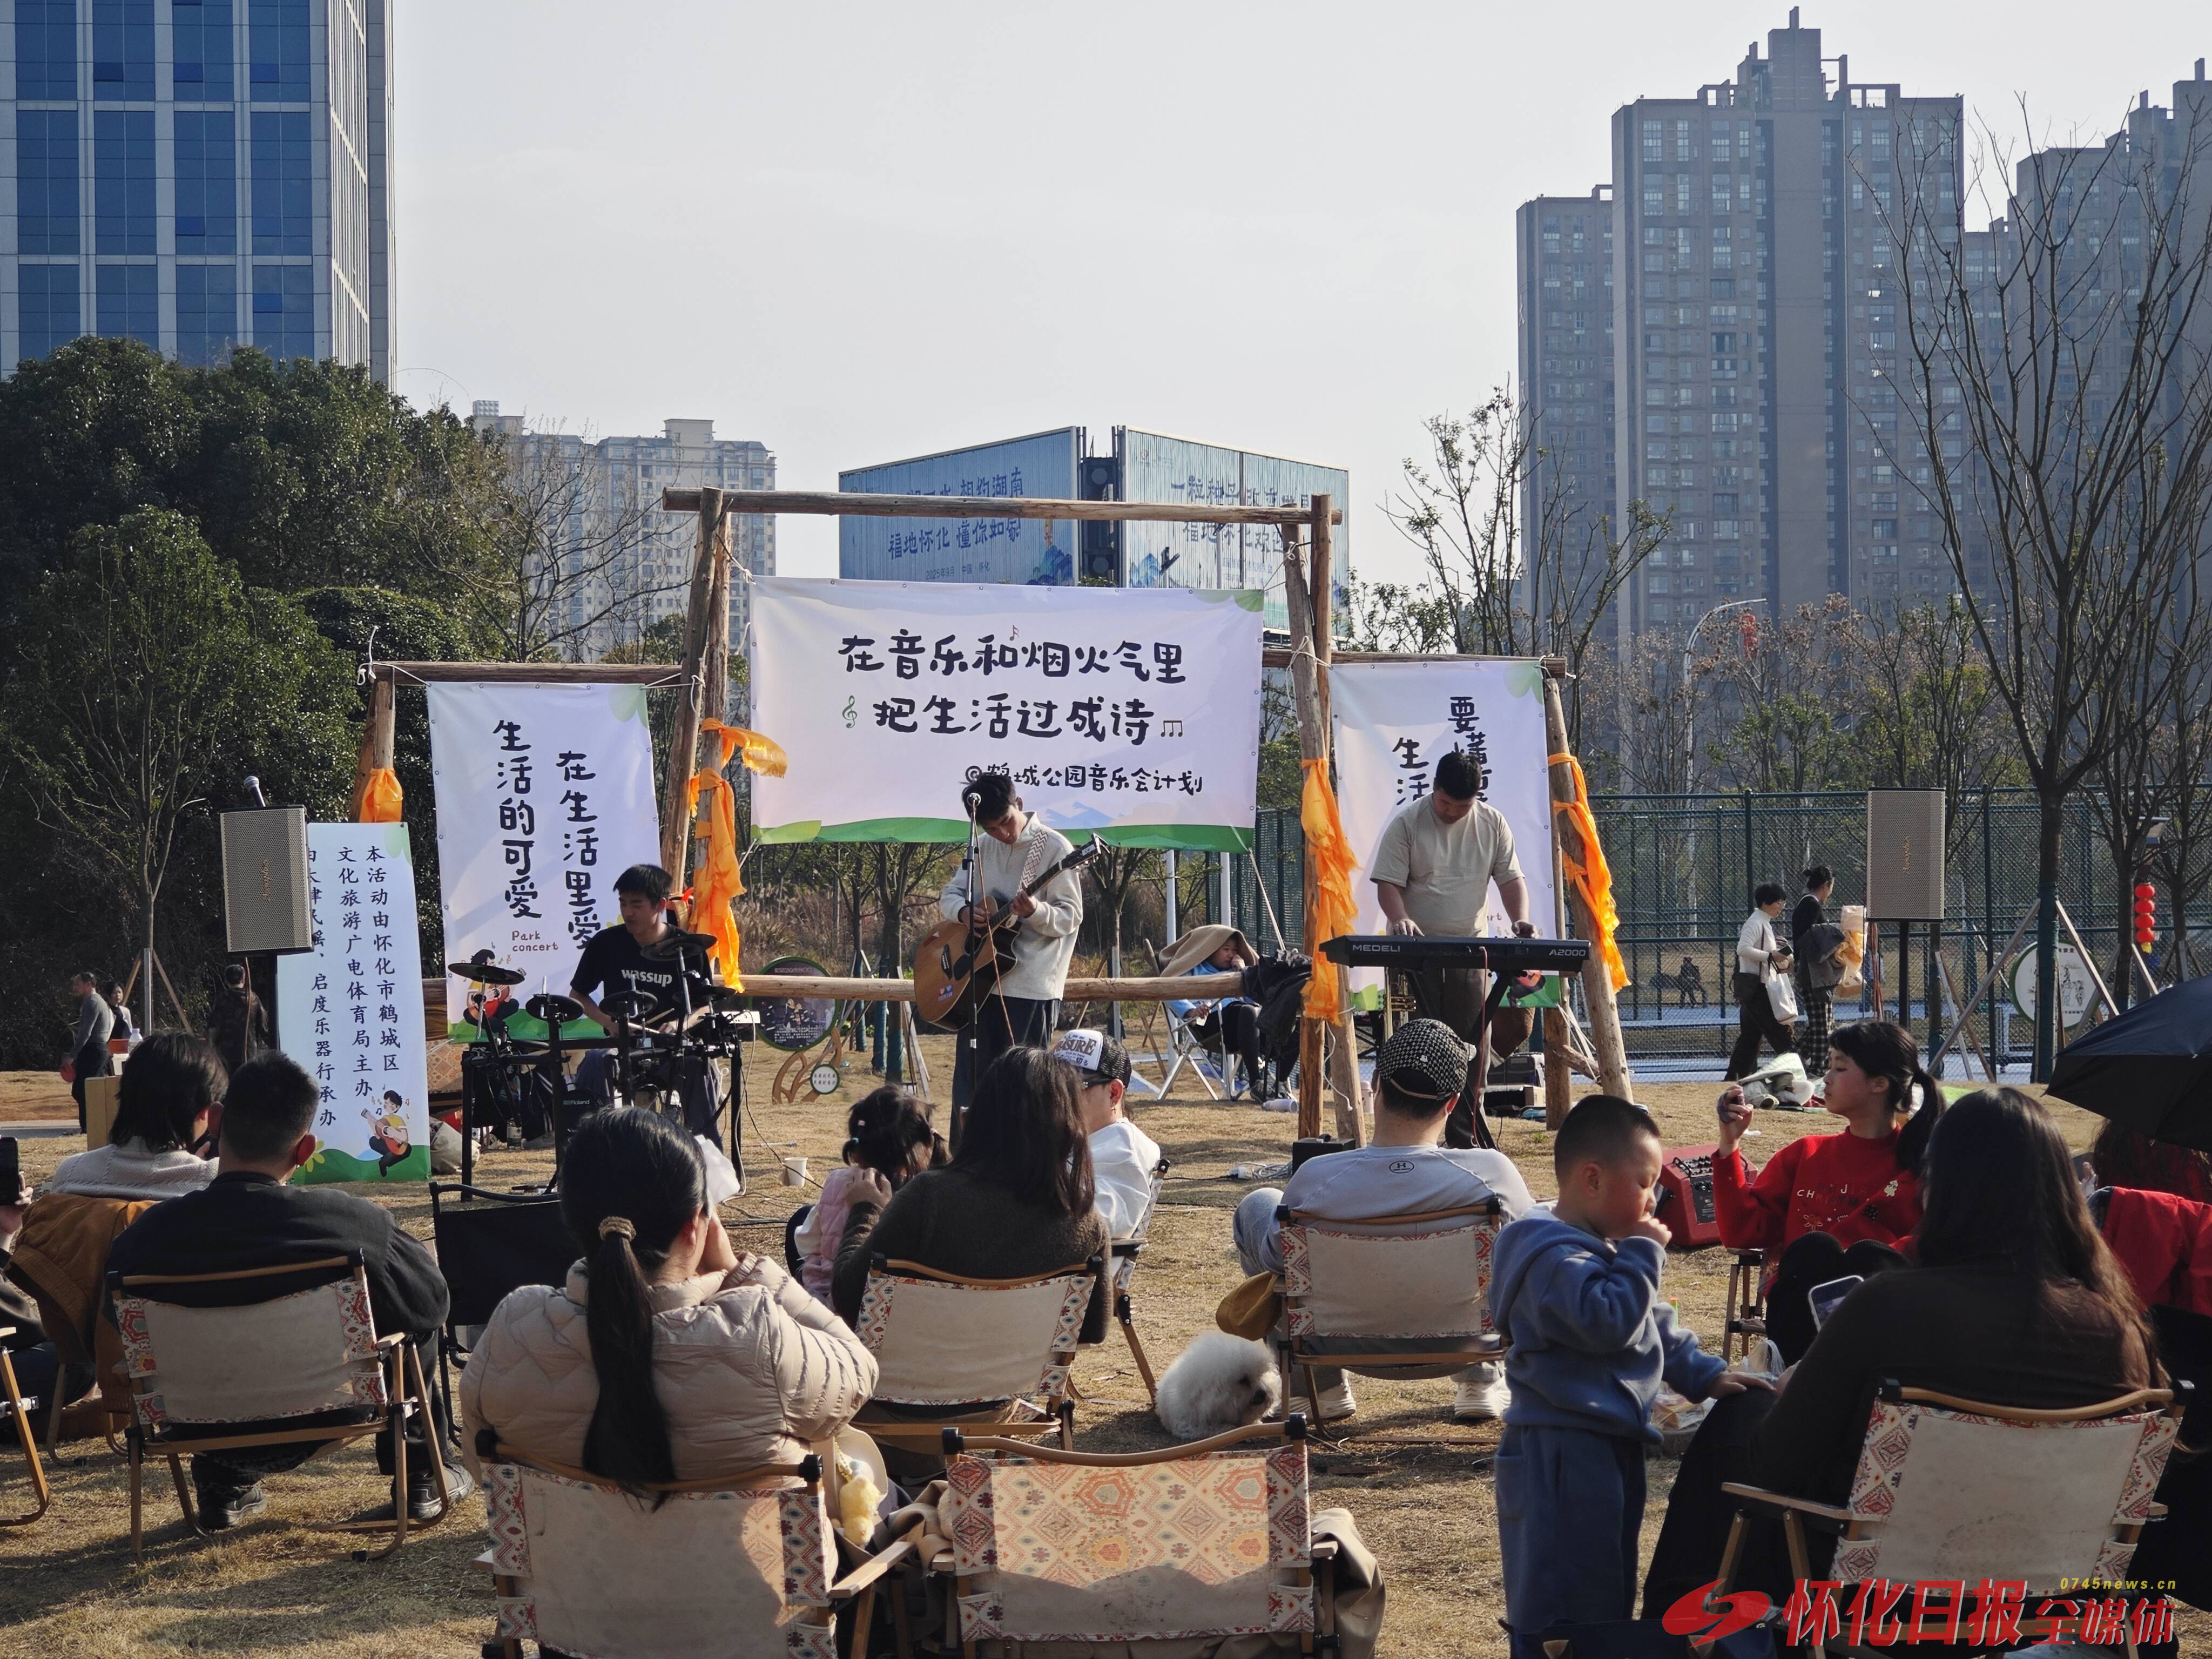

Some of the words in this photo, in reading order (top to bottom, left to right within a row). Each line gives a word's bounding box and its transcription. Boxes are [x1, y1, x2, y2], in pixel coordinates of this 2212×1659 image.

[888, 527, 950, 560] 福地怀化
[838, 629, 1186, 684] 在音乐和烟火气里
[873, 692, 1155, 746] 把生活过成诗
[493, 720, 542, 919] 生活的可爱
[556, 751, 601, 949] 在生活里爱
[366, 846, 400, 1071] 本活动由怀化市鹤城区
[512, 930, 541, 941] Park
[512, 942, 558, 952] concert
[338, 846, 373, 1098] 文化旅游广电体育局主办
[621, 969, 672, 987] wassup
